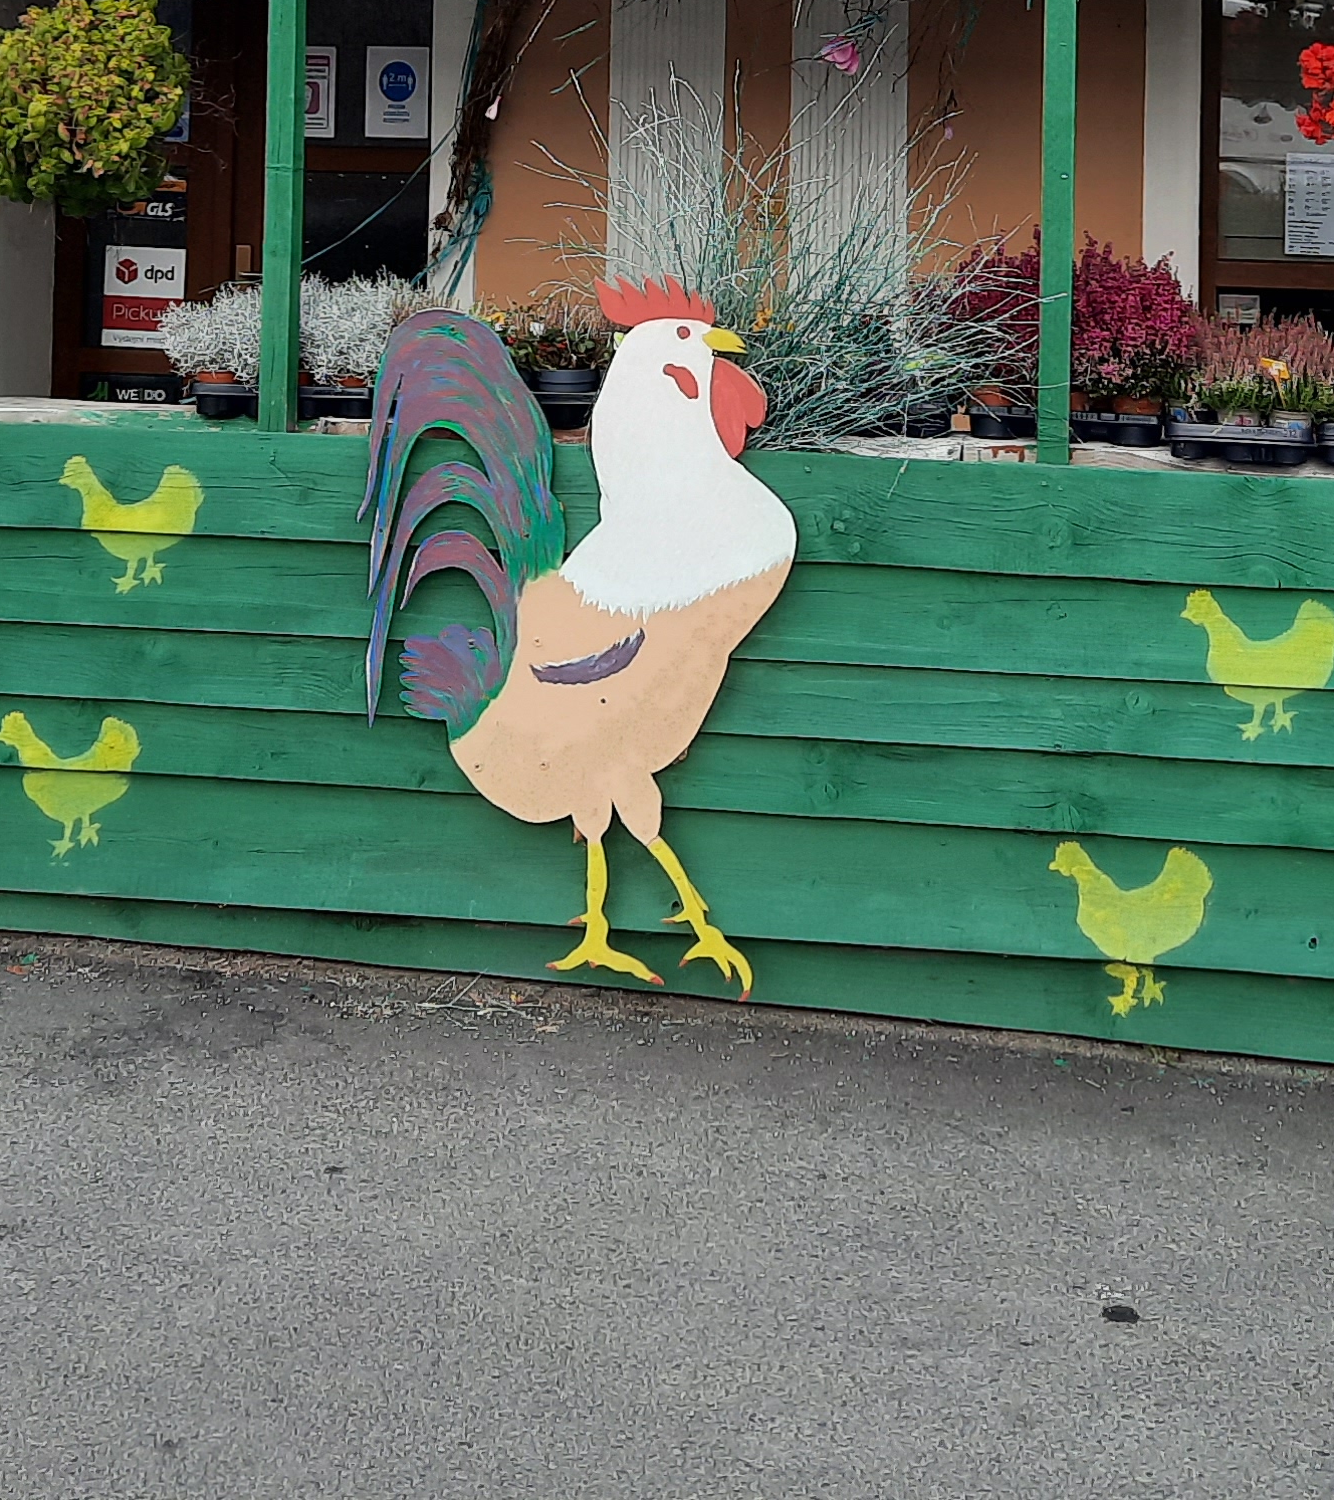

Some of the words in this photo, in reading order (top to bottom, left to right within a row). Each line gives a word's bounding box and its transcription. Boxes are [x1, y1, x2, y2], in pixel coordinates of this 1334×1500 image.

[388, 72, 395, 82] 2
[146, 202, 175, 216] GLS
[144, 264, 175, 284] dpd
[112, 303, 165, 322] Picku
